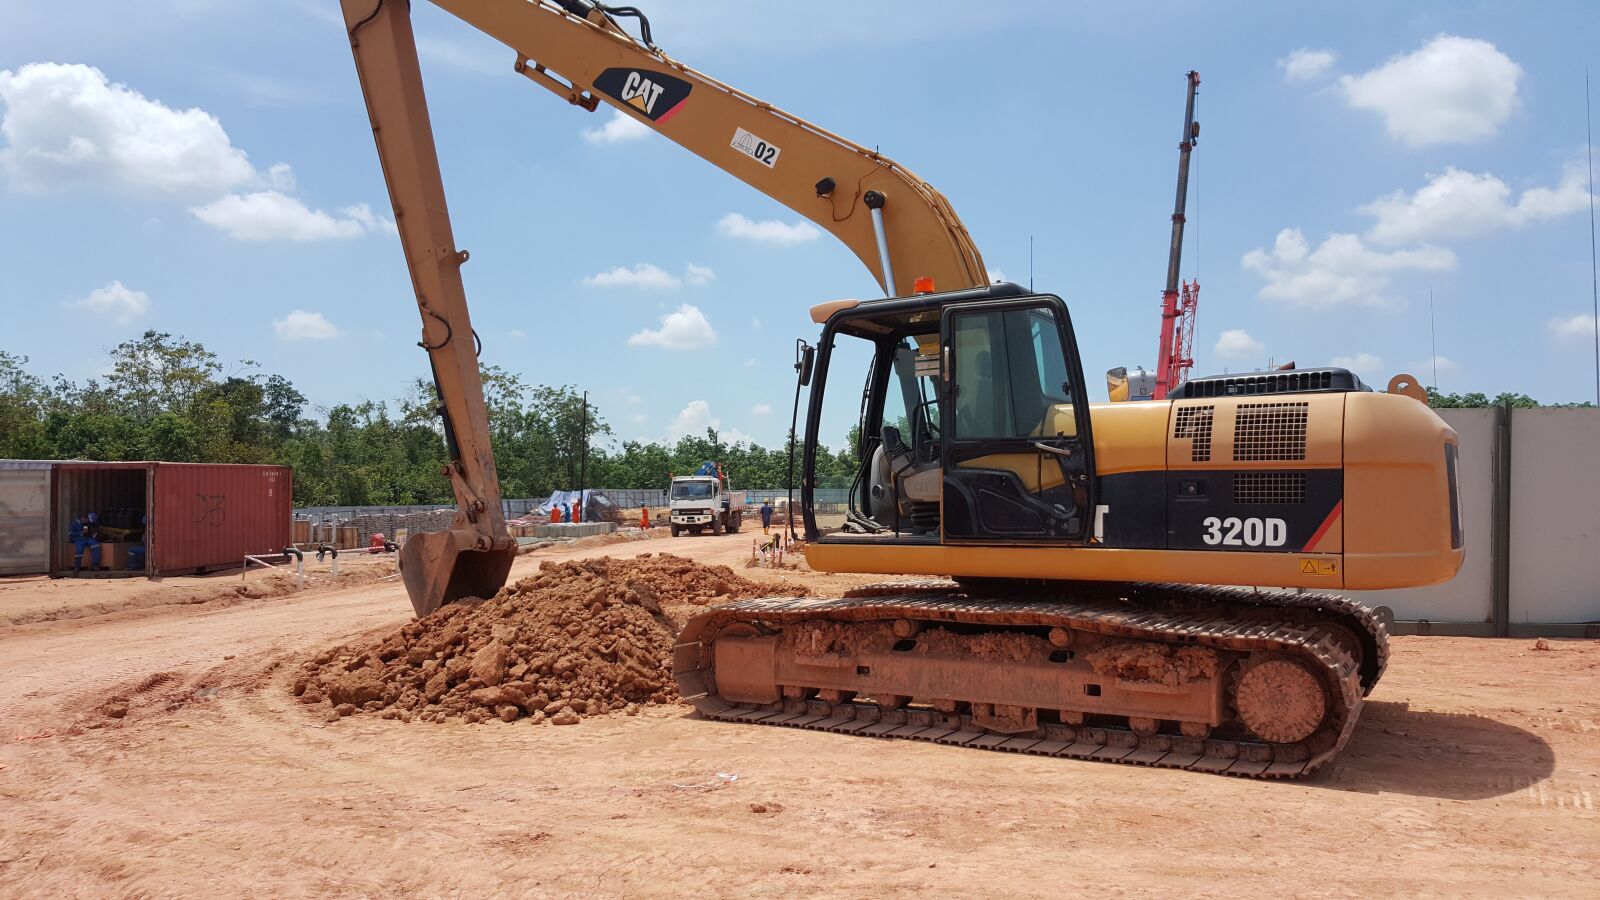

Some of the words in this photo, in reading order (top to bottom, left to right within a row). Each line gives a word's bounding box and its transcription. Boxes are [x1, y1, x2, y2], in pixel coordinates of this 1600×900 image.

[621, 71, 665, 114] CAT
[754, 141, 776, 165] 02
[1202, 516, 1287, 547] 320D
